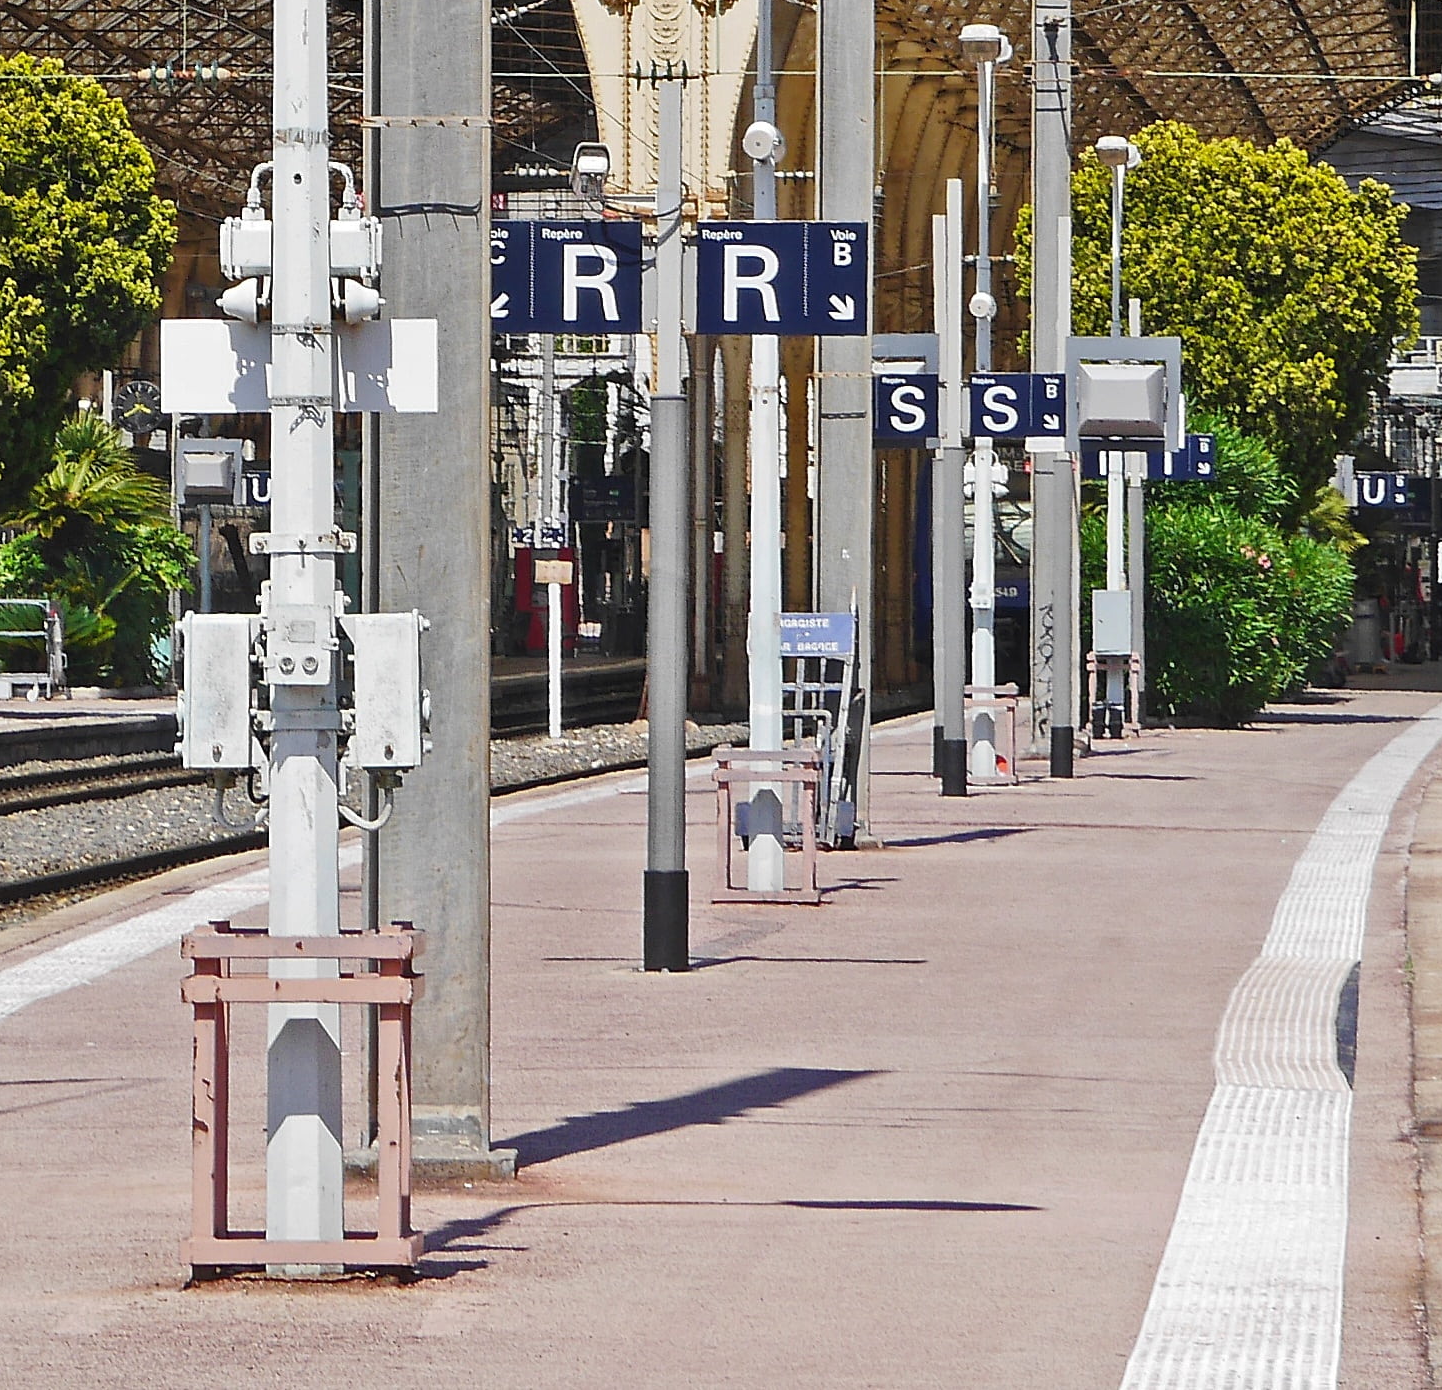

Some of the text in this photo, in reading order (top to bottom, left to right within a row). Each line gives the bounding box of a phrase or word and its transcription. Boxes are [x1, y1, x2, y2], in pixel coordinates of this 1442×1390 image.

[491, 228, 509, 239] oie
[542, 228, 583, 241] Repère
[702, 229, 743, 242] Repère
[830, 229, 857, 241] Voie
[833, 242, 852, 266] B
[563, 244, 620, 321] R
[723, 244, 781, 322] R
[1046, 384, 1058, 399] B
[890, 385, 926, 432] S
[982, 385, 1019, 432] S
[1362, 478, 1386, 504] U
